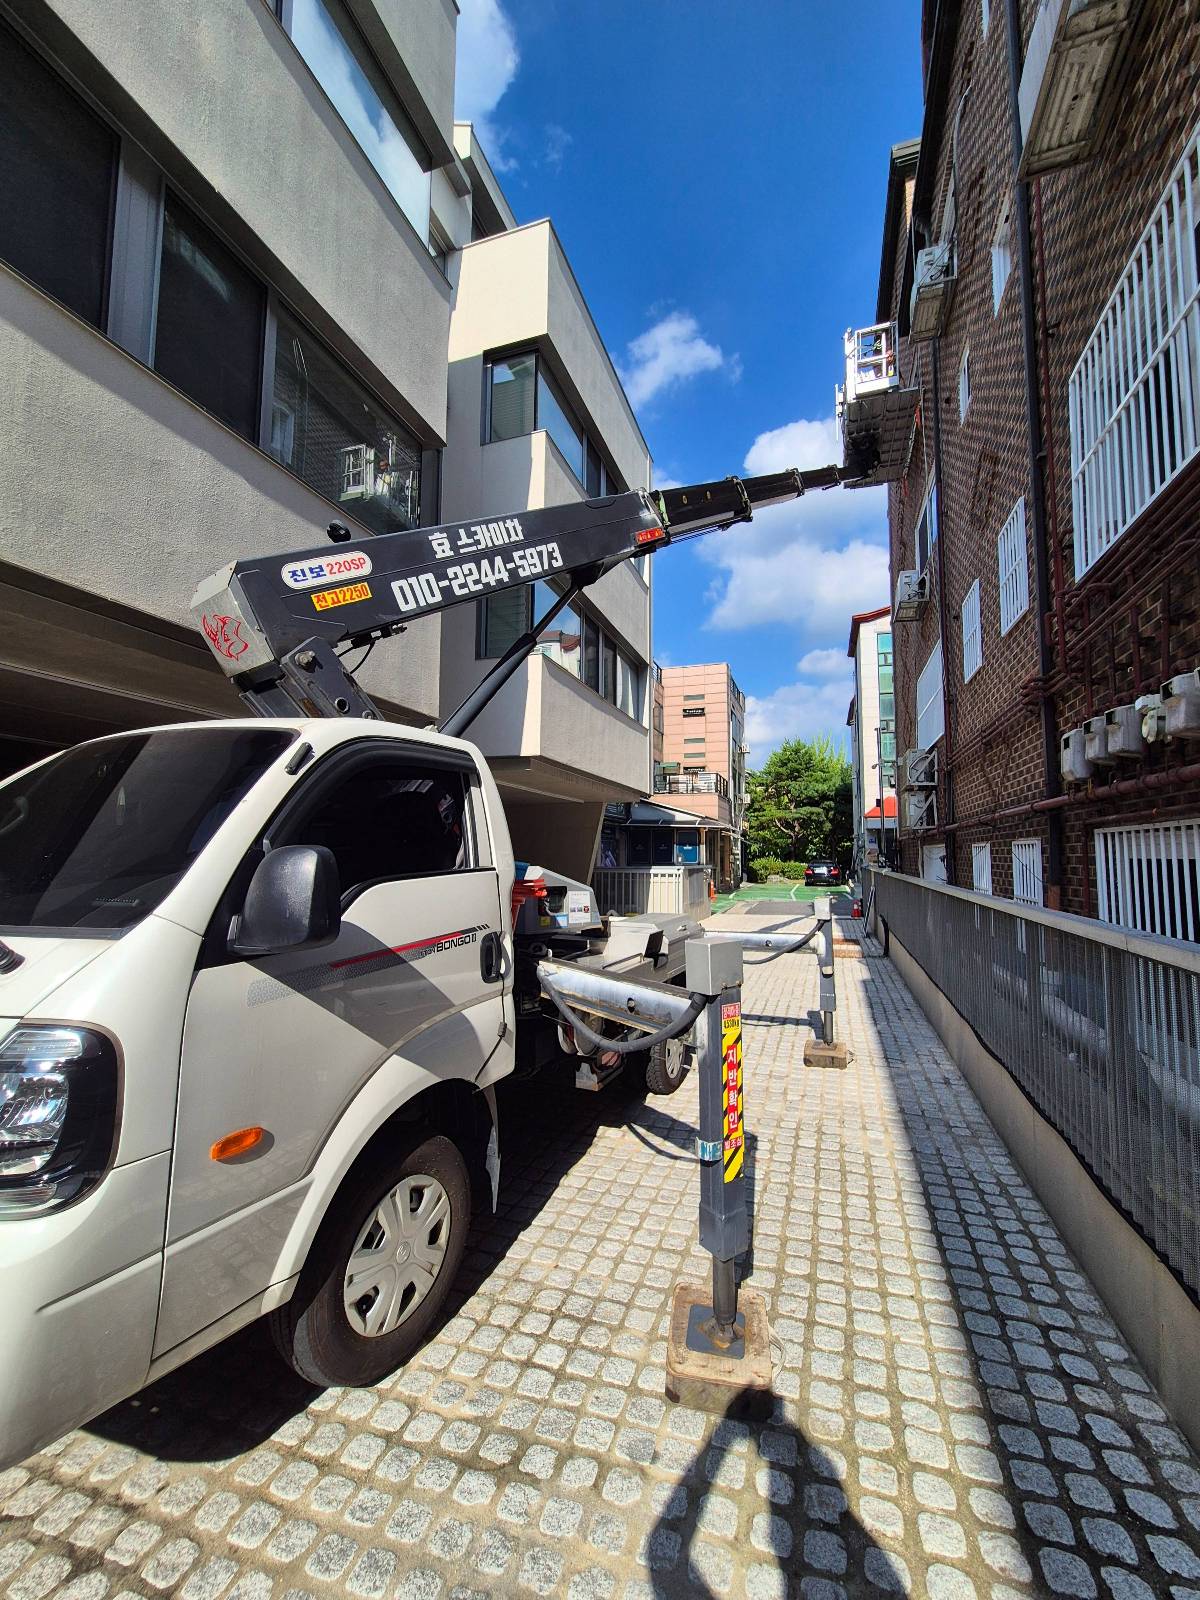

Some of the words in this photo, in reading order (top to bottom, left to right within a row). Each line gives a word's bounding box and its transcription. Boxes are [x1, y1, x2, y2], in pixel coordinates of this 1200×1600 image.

[428, 531, 454, 559] 효
[457, 518, 524, 553] 스카이차
[288, 564, 327, 583] 진보
[326, 557, 366, 575] 220SP
[390, 542, 564, 612] 010-2244-5973
[436, 935, 471, 953] BONGO
